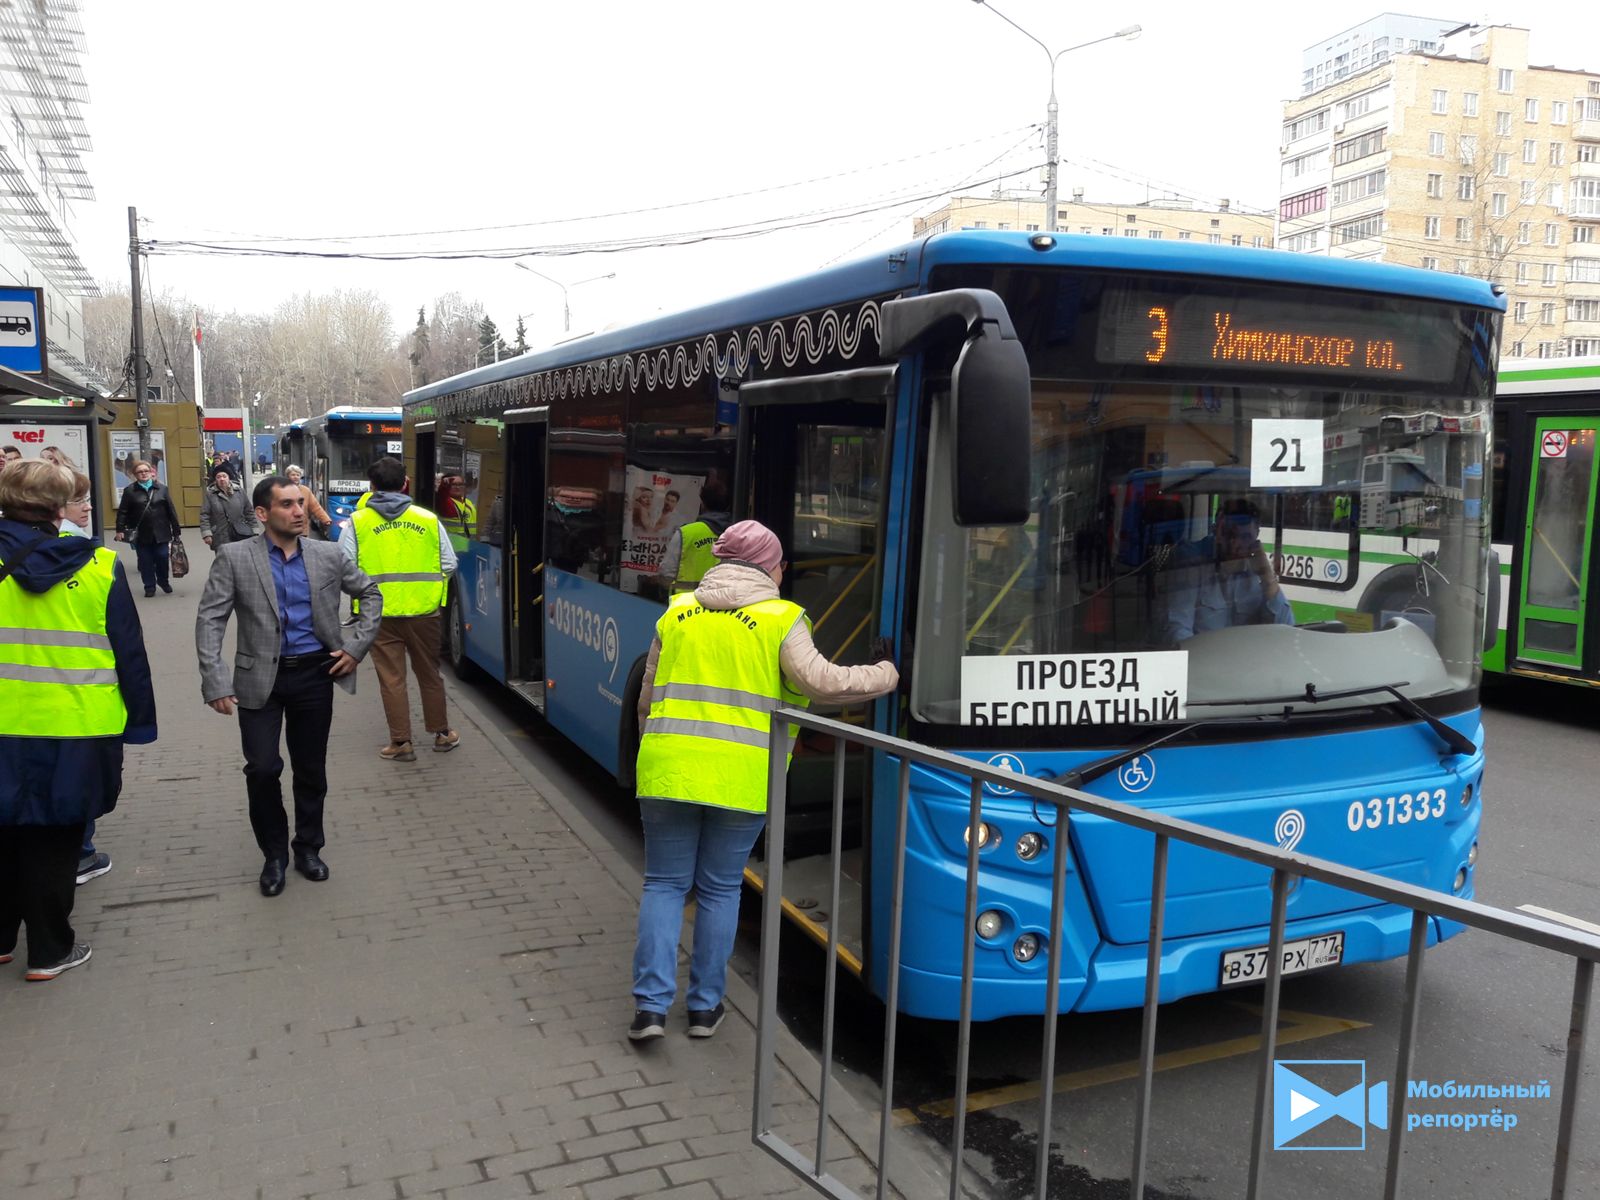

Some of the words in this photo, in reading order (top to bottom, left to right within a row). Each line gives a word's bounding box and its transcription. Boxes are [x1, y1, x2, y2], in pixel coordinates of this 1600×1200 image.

[1146, 307, 1168, 362] 3
[1212, 312, 1355, 367] Химкинское
[1365, 340, 1405, 370] кл.
[365, 424, 373, 433] 3
[1270, 437, 1306, 472] 21
[372, 521, 426, 536] МОСГОРТРАНС
[1269, 552, 1314, 578] 0256
[555, 597, 601, 652] 031333
[1017, 658, 1139, 692] ПРОЕЗД
[970, 690, 1179, 726] БЕСПЛАТНЫЙ
[1347, 788, 1447, 832] 031333
[1315, 955, 1328, 964] RUS
